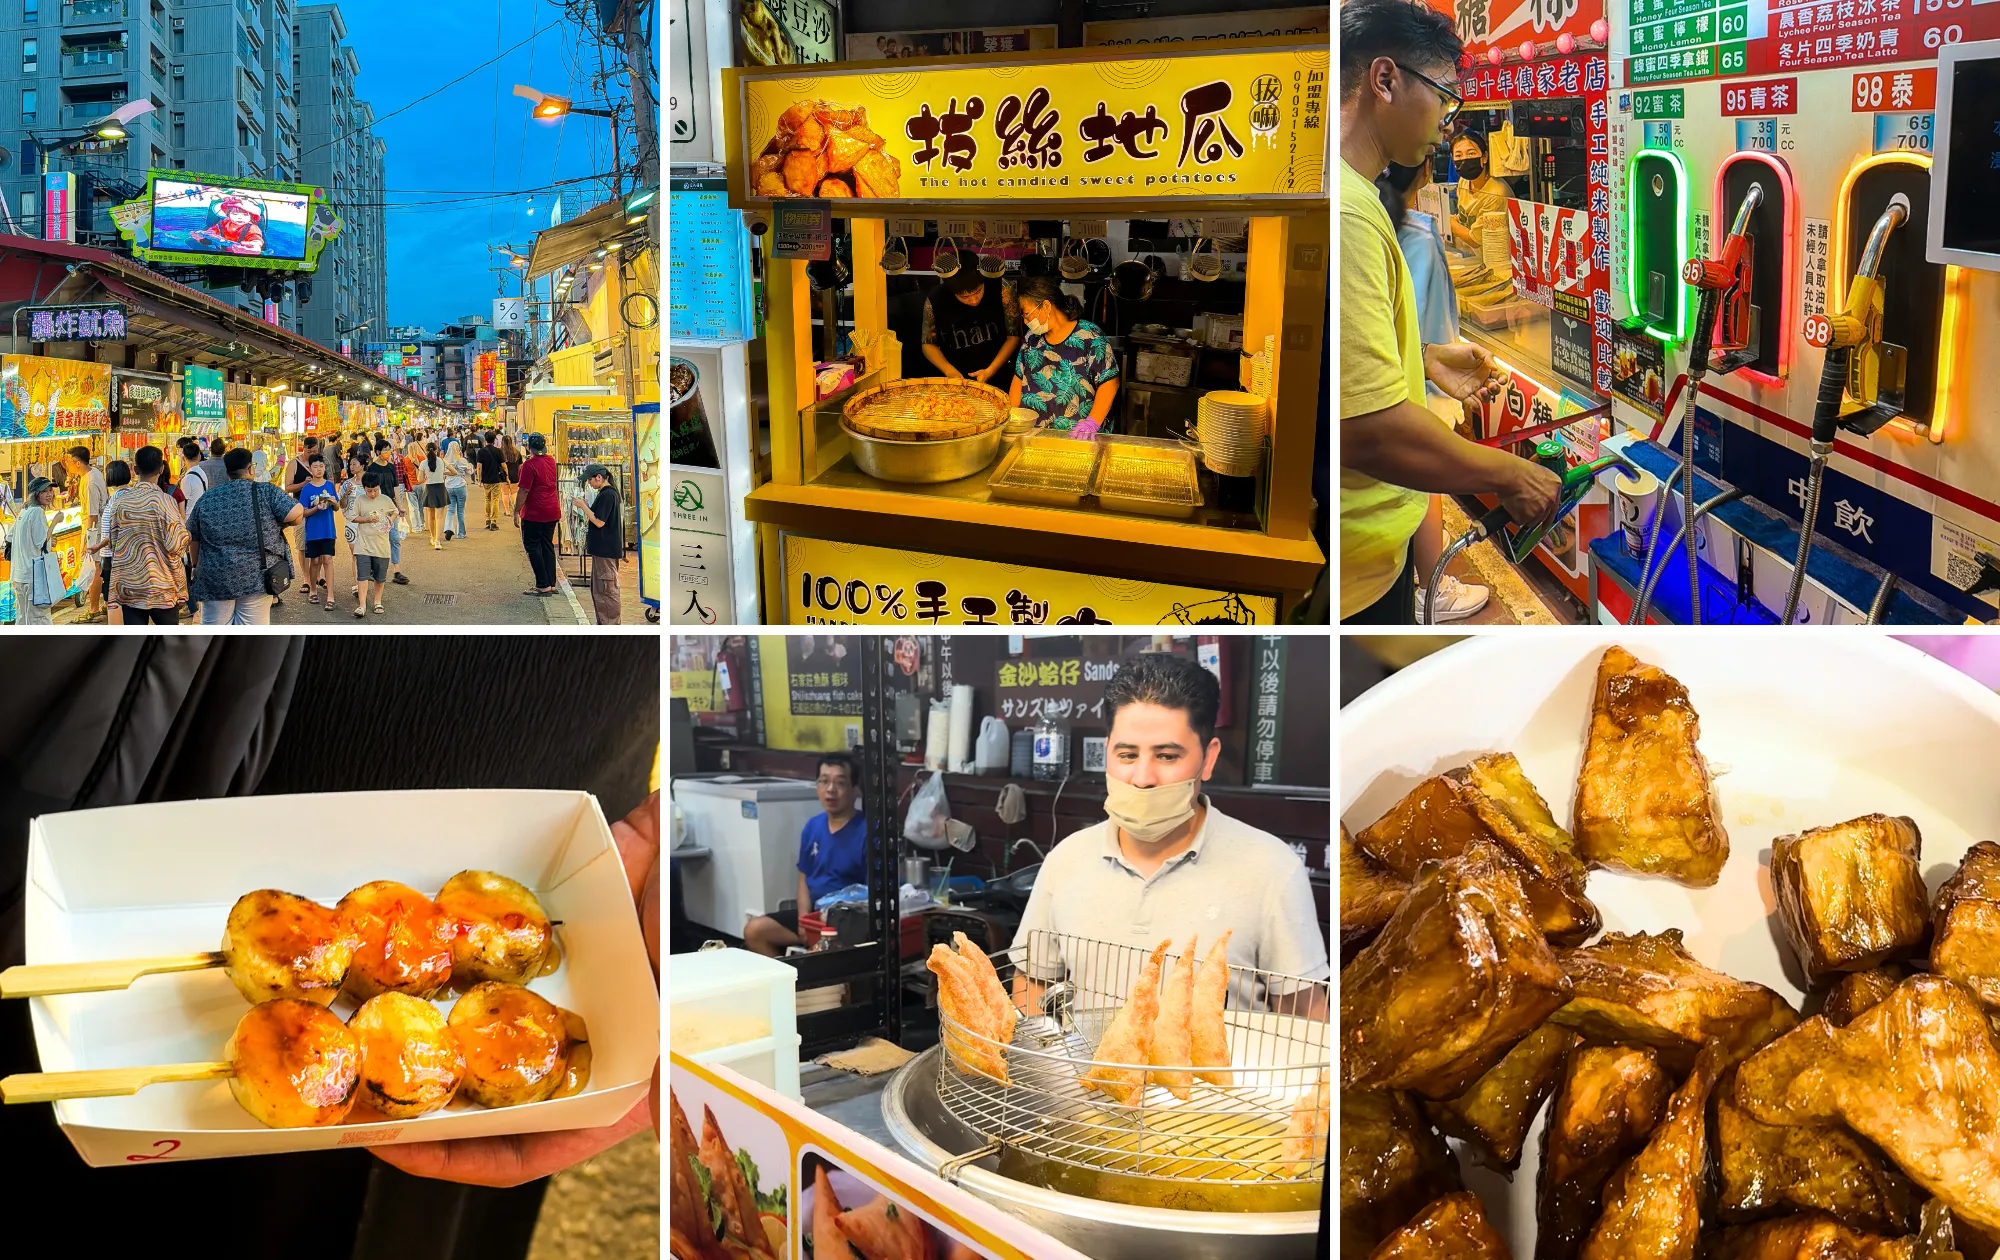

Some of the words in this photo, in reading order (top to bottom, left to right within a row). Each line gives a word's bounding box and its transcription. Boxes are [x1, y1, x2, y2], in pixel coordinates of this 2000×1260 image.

[1722, 15, 1744, 34] 60
[1778, 26, 1811, 38] Lychee
[1812, 23, 1836, 33] Four
[1838, 17, 1879, 29] Season
[1881, 12, 1901, 22] Tea
[1641, 42, 1668, 52] Honey
[1670, 36, 1702, 47] Lemon
[1779, 28, 1899, 59] 冬片四季奶青
[1923, 25, 1963, 49] 60
[1722, 51, 1744, 69] 65
[1779, 58, 1802, 67] Four
[1803, 54, 1842, 65] Season
[1845, 51, 1865, 60] Tea
[1867, 49, 1898, 58] Latte
[1458, 57, 1605, 98] 四十年傳家老店
[1304, 70, 1324, 129] 加盟專線
[1659, 124, 1668, 133] 50
[1674, 125, 1681, 135] 元
[1759, 122, 1772, 133] 35
[1781, 124, 1791, 135] 元
[1910, 116, 1931, 130] 65
[1654, 136, 1669, 146] 700
[1674, 140, 1684, 148] CC
[1752, 136, 1772, 148] 700
[1781, 140, 1794, 150] CC
[1898, 134, 1929, 149] 700
[920, 177, 949, 187] The
[959, 176, 987, 187] hot
[997, 175, 1070, 187] candied
[1080, 174, 1135, 186] sweet
[1145, 171, 1237, 187] potatoes
[1684, 262, 1699, 278] 95
[1805, 319, 1828, 343] 98
[1541, 443, 1559, 453] 92
[673, 512, 696, 521] THREE
[802, 572, 908, 620] 100%
[941, 635, 953, 697] 中午以後
